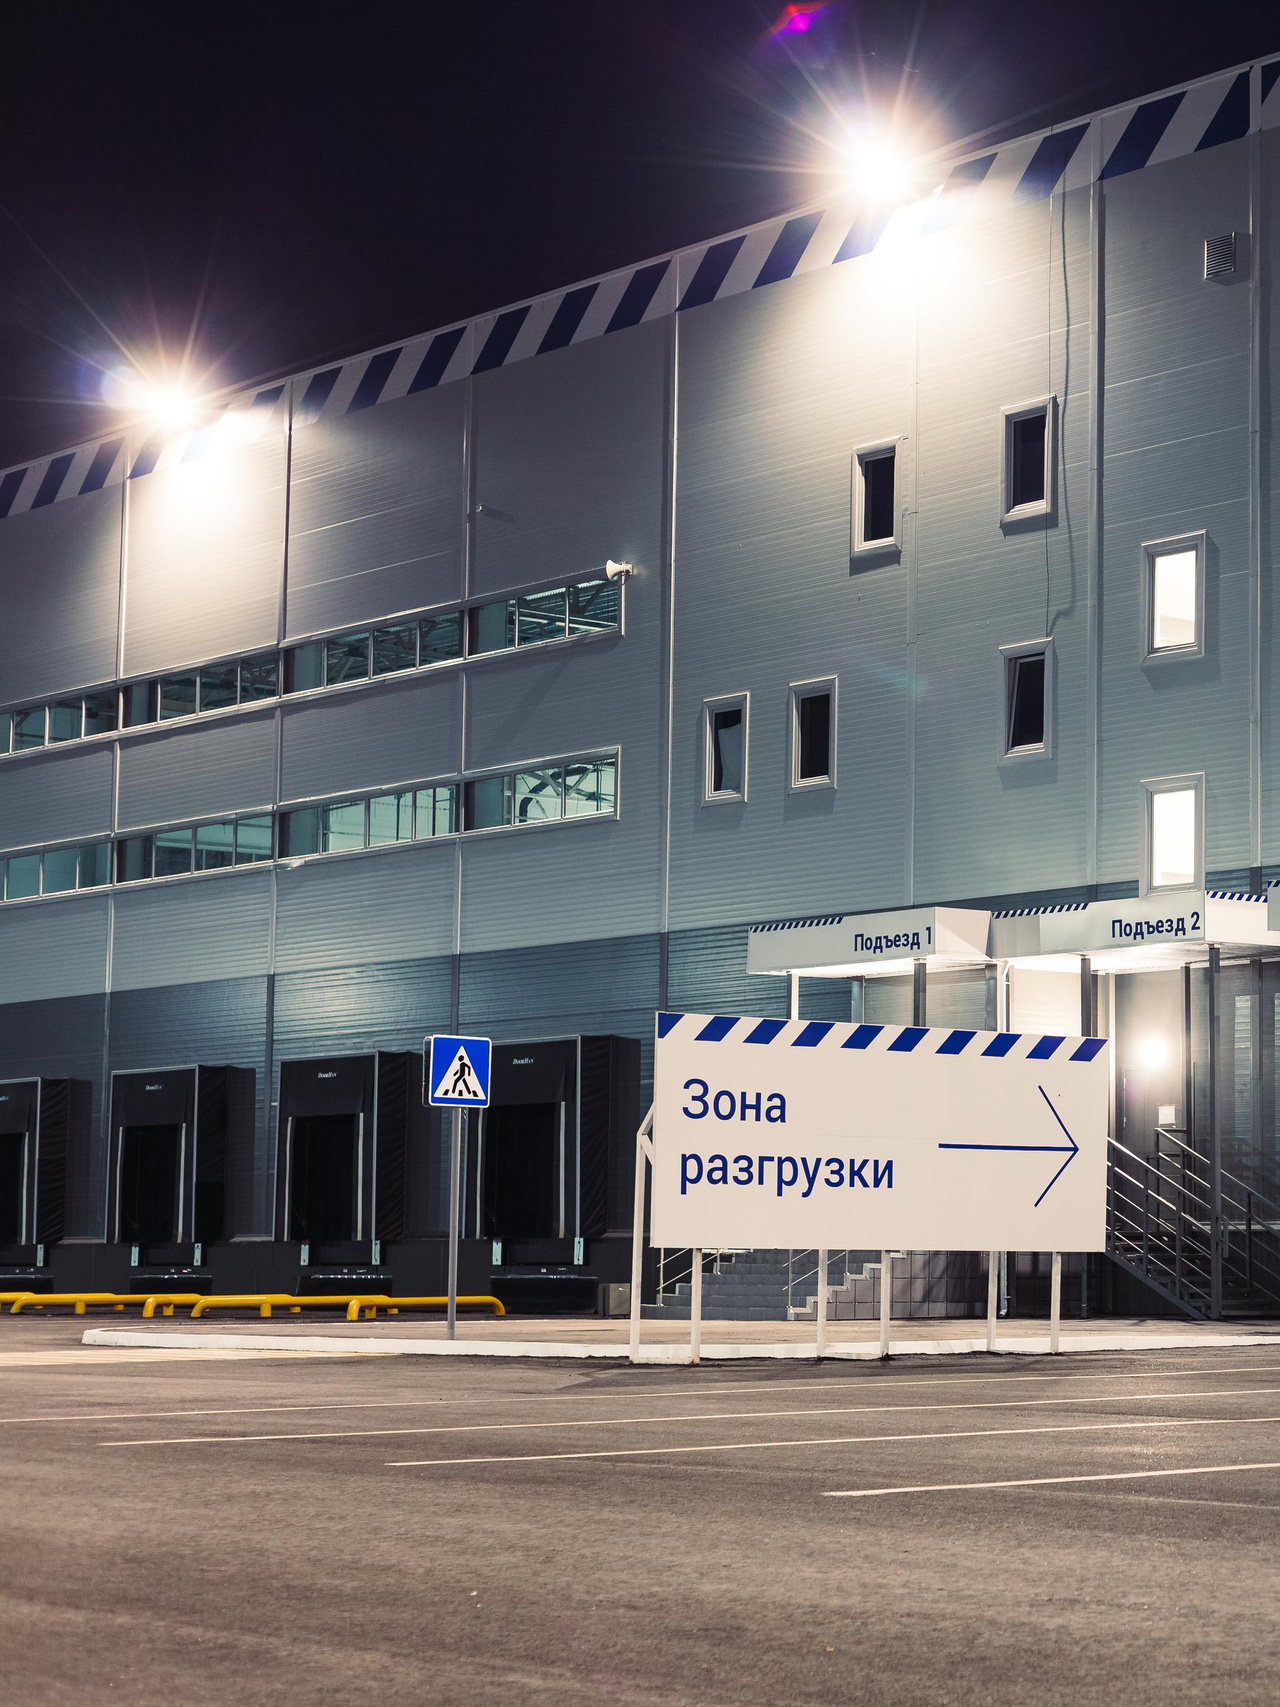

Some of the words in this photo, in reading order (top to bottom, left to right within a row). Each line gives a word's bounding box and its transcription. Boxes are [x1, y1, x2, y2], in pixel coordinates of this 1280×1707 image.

[854, 932, 921, 954] Подъезд
[926, 926, 931, 945] 1
[1112, 917, 1186, 940] Подъезд
[1190, 911, 1201, 930] 2
[682, 1078, 787, 1123] Зона
[680, 1153, 894, 1198] разгрузки
